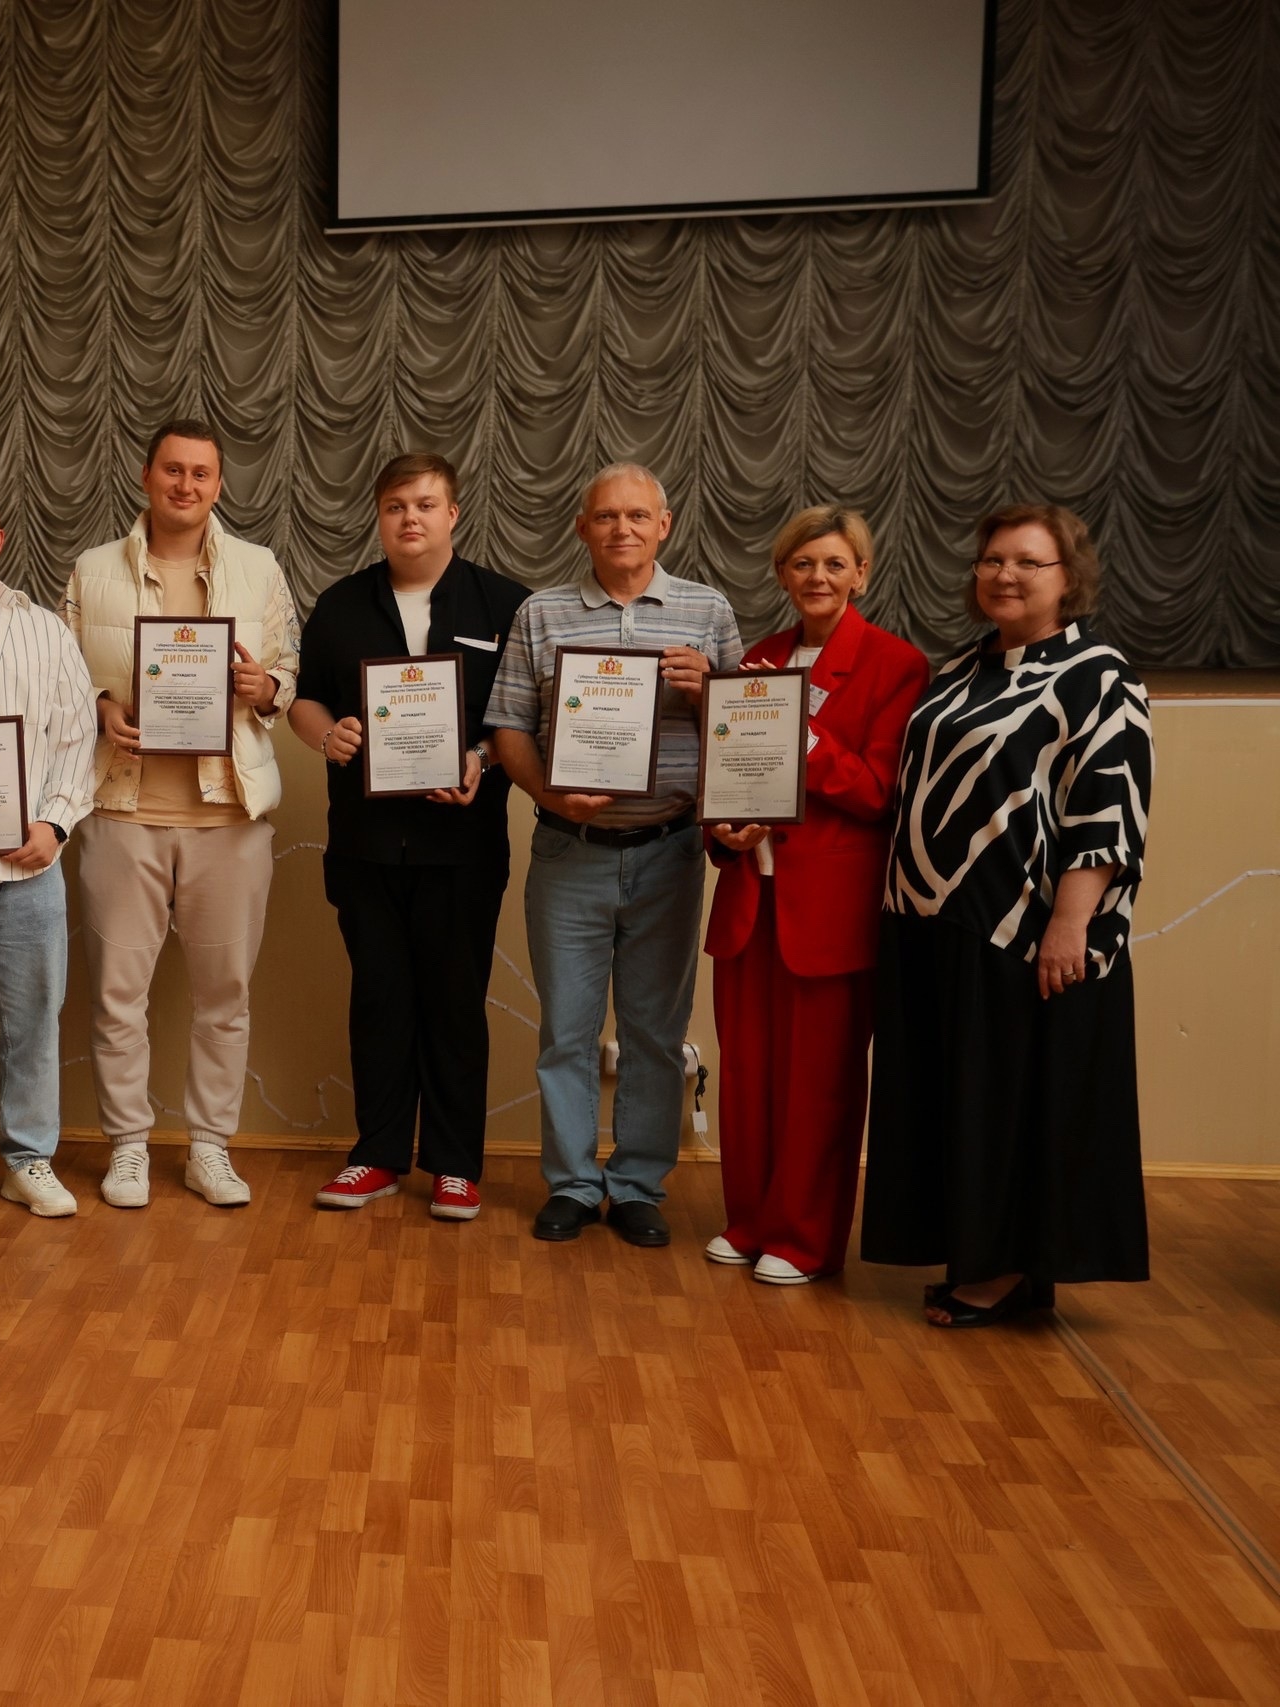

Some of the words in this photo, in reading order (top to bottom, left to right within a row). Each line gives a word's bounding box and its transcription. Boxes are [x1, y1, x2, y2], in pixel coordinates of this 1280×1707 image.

[161, 654, 207, 664] ДИПЛОМ
[582, 686, 633, 697] ДИПЛОМ
[390, 693, 436, 706] ДИПЛОМ
[730, 710, 779, 723] ДИПЛОМ
